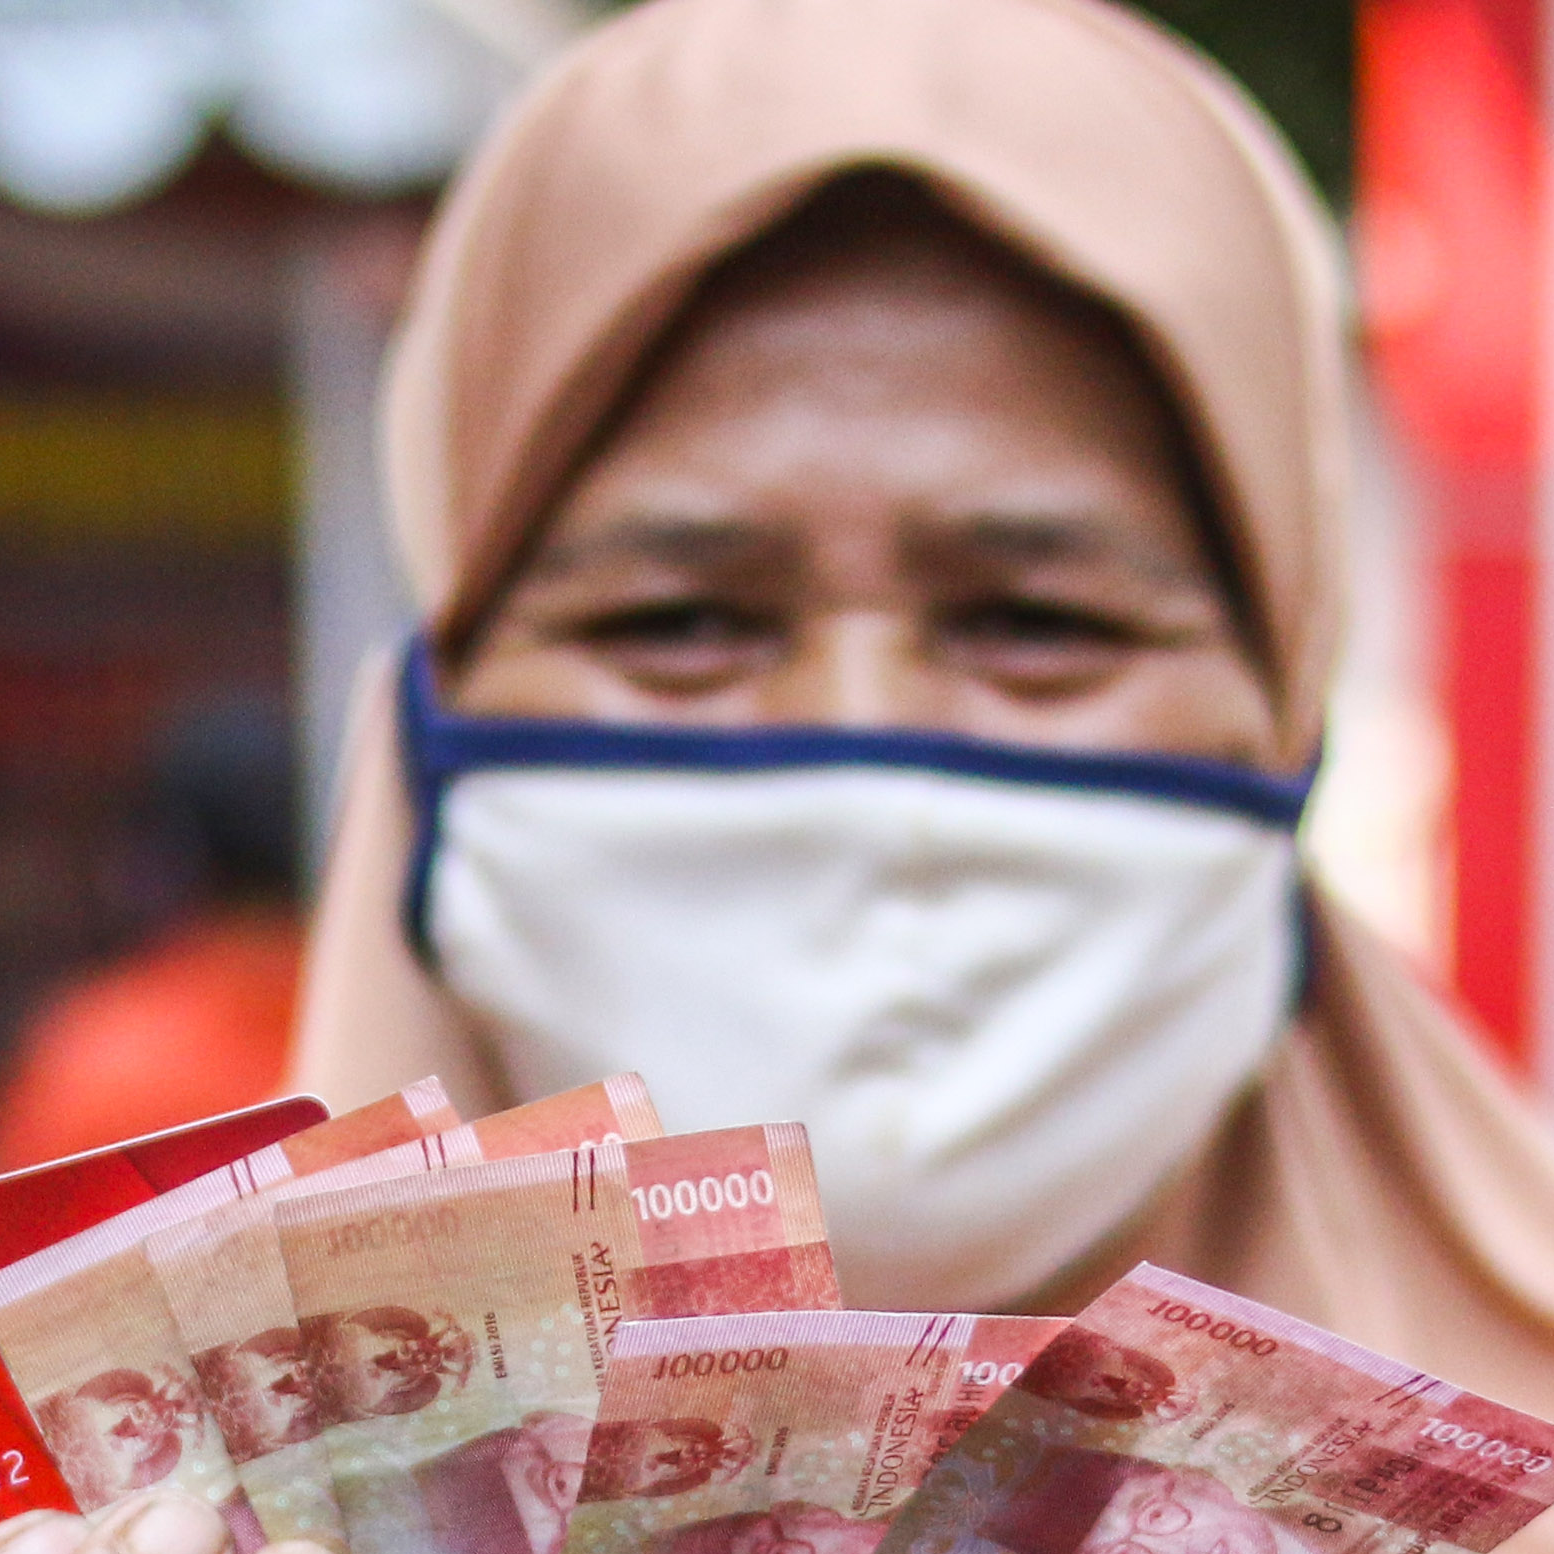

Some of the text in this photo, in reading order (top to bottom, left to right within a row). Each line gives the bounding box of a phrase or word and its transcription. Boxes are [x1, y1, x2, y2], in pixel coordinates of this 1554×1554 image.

[631, 1169, 774, 1221] 100000
[571, 1252, 591, 1308] REPUBLIK
[484, 1311, 508, 1379] EMISI 2016
[1147, 1299, 1279, 1357] 100000
[652, 1347, 789, 1381] 100000
[958, 1360, 1025, 1386] 100
[859, 1387, 925, 1516] INDONESIA
[1249, 1420, 1373, 1504] INDONESIA
[1419, 1417, 1553, 1474] 100000
